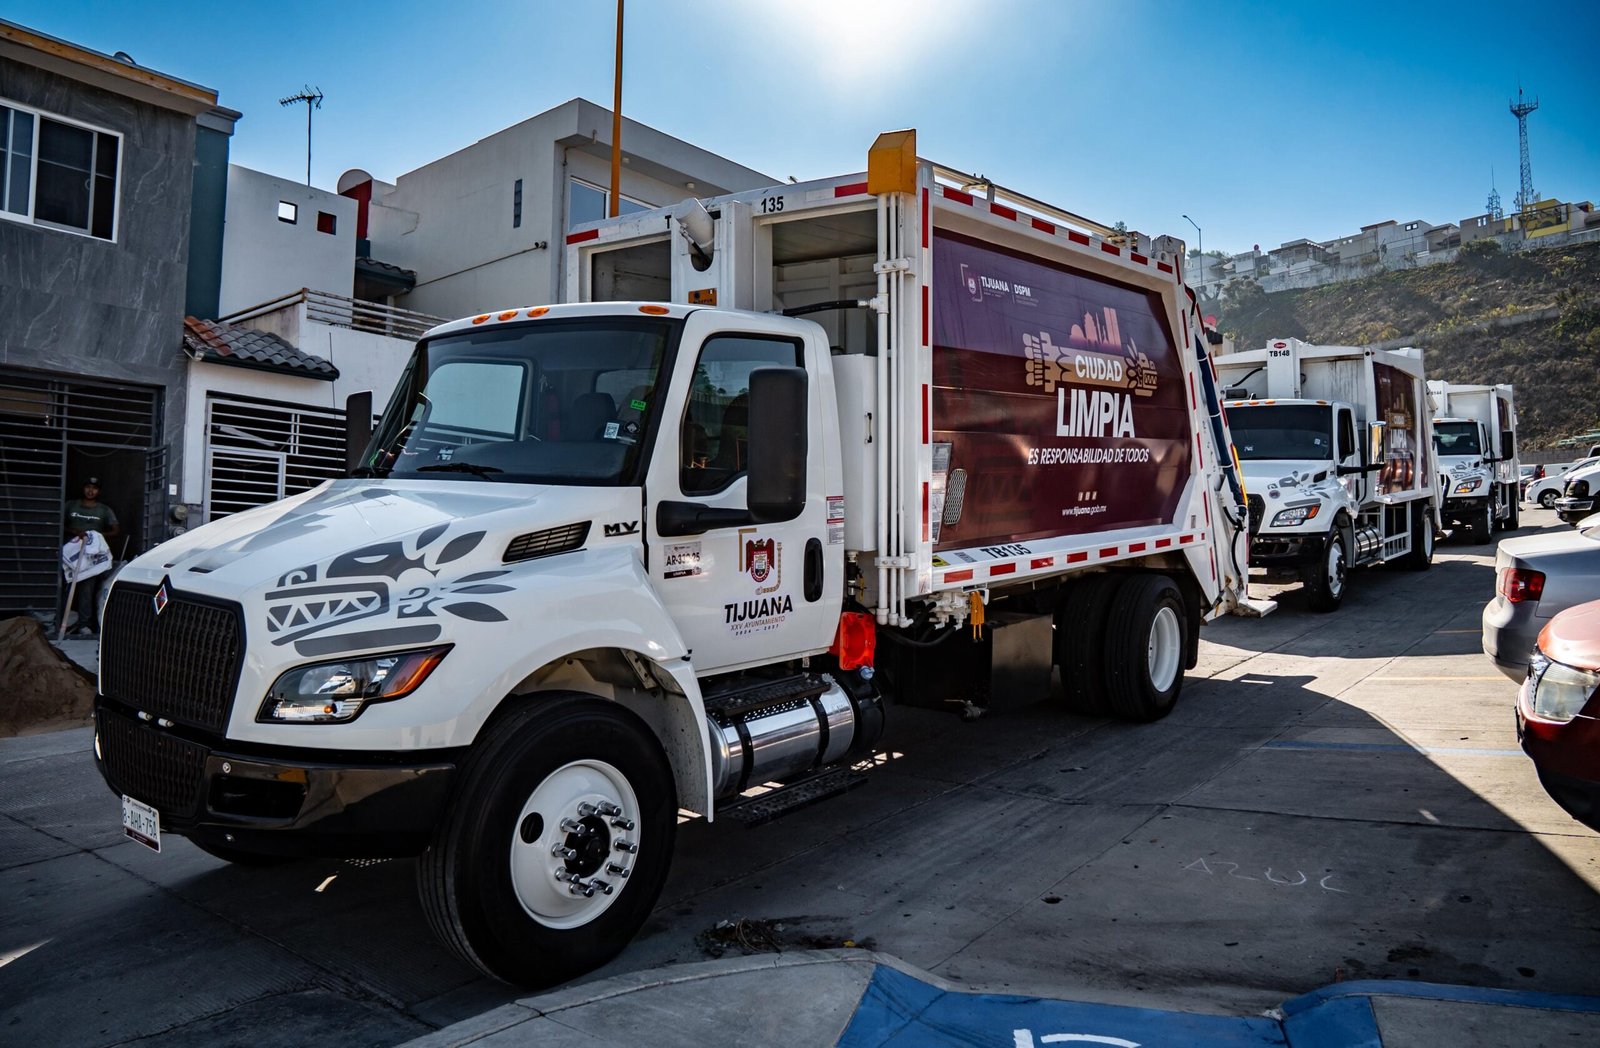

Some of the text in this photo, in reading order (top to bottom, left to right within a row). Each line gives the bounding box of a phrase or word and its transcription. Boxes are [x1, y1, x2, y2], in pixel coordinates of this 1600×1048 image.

[664, 195, 784, 229] T 135
[980, 275, 1010, 293] TIJUANA
[1013, 284, 1032, 298] DSPM
[1269, 349, 1290, 357] TB148
[1075, 354, 1123, 382] CIUDAD
[1056, 387, 1136, 438] LIMPIA
[1027, 447, 1150, 465] ES RESPONSABILIDAD DE TODOS
[603, 520, 638, 535] MV
[980, 543, 1032, 559] TB135
[724, 594, 793, 624] TIJUANA
[731, 615, 786, 631] XXV AYUNTAMIENTO
